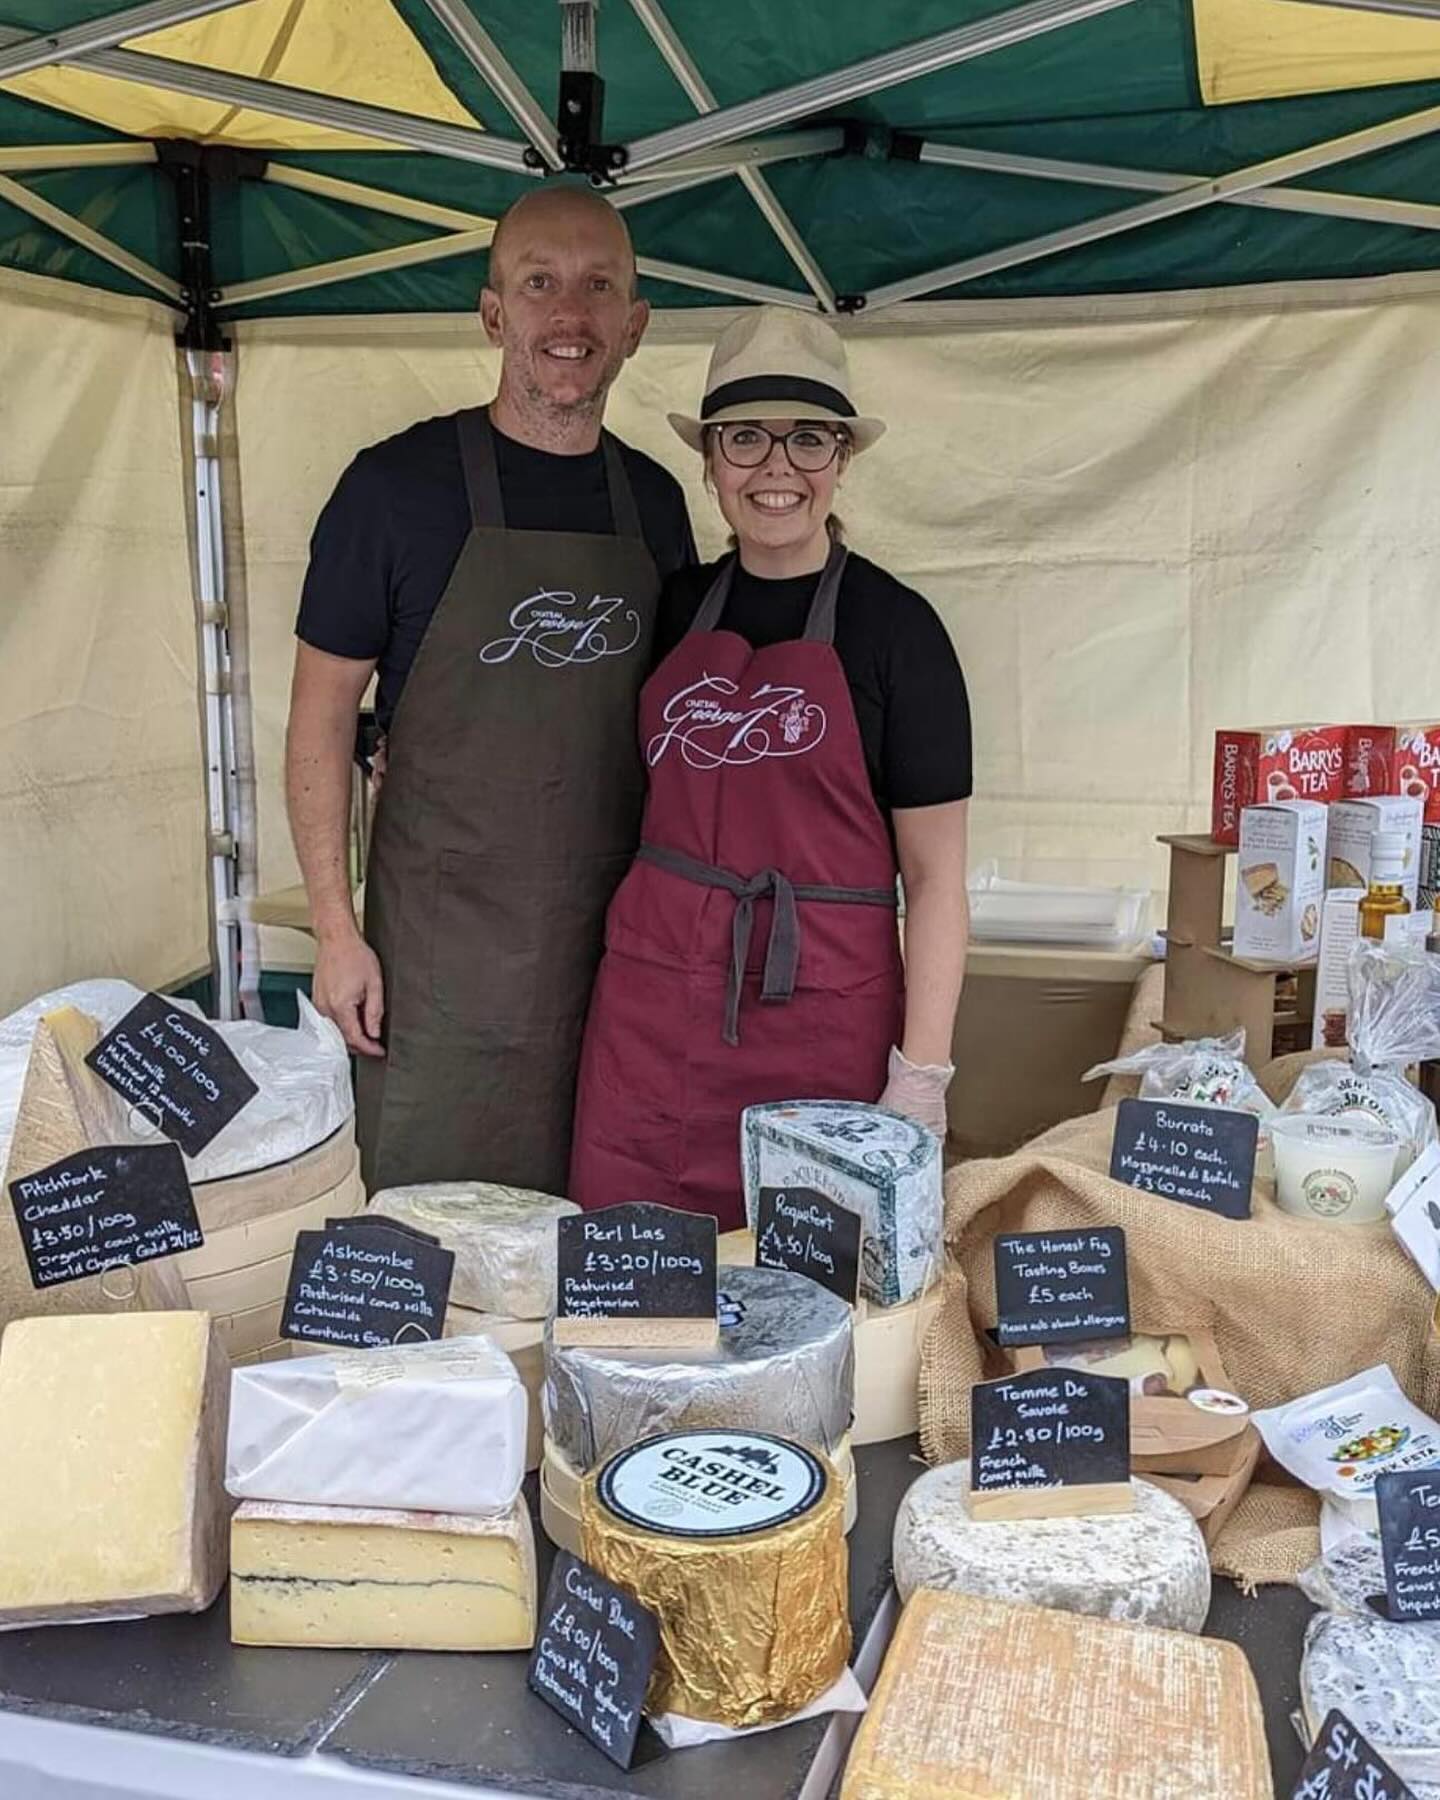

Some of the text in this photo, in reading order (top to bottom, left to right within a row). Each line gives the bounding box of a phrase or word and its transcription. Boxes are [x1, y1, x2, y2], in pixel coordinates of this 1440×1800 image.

[1289, 743, 1343, 775] BARRY'S
[1300, 771, 1328, 793] TEA
[1223, 803, 1237, 832] TEA
[1156, 1110, 1214, 1136] Burrata
[1134, 1131, 1188, 1156] £4.10
[1188, 1166, 1199, 1179] di
[1177, 1187, 1212, 1201] each
[24, 1189, 105, 1221] Cheddar
[776, 1193, 834, 1232] Roquefort
[144, 1220, 182, 1238] milk
[584, 1222, 666, 1242] Perl Las
[322, 1241, 415, 1270] Ashcombe
[1001, 1236, 1111, 1257] The Honest Fig
[37, 1262, 83, 1282] World
[85, 1253, 132, 1271] Cheese
[136, 1242, 168, 1258] Gold
[1012, 1260, 1106, 1279] Tasting Boxes
[565, 1296, 640, 1312] Vegetarian
[1028, 1285, 1094, 1304] £5 each
[302, 1324, 359, 1343] Contains
[995, 1380, 1089, 1401] Tomme De
[1017, 1403, 1070, 1418] Savoie
[979, 1454, 1027, 1469] French
[1015, 1464, 1047, 1478] milk
[662, 1447, 787, 1501] CASHEL
[658, 1466, 751, 1506] BLUE
